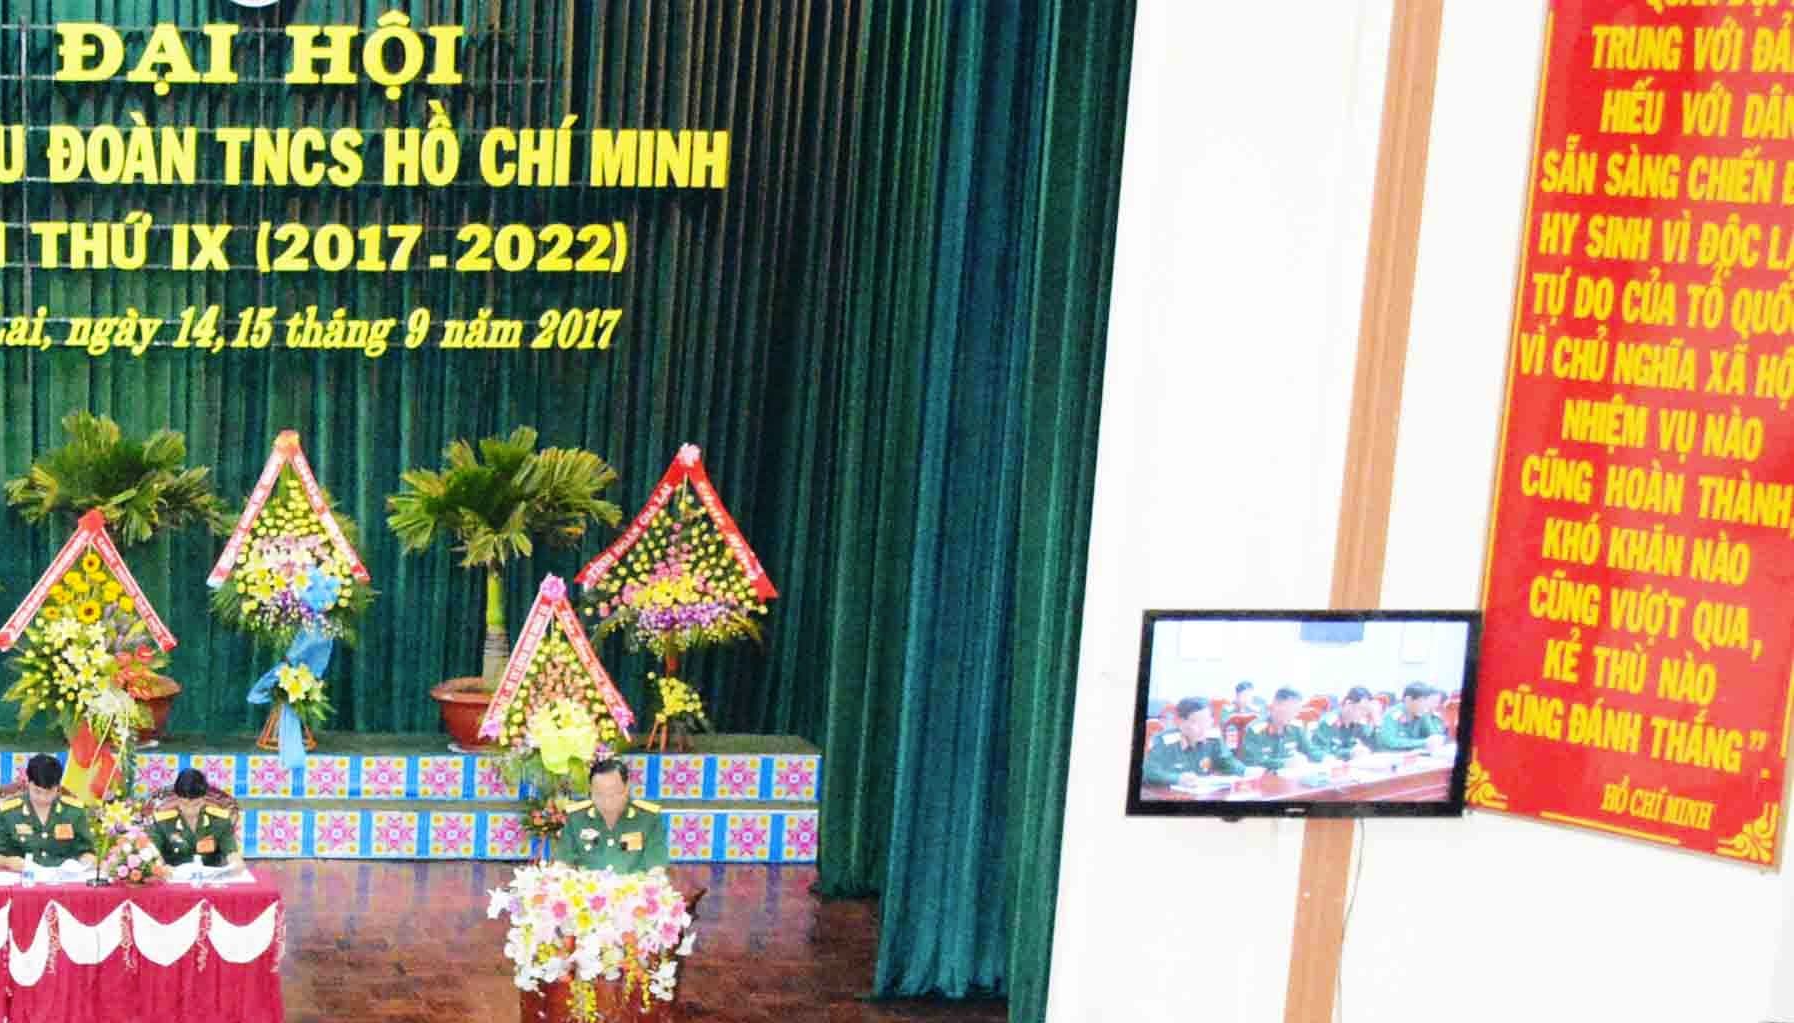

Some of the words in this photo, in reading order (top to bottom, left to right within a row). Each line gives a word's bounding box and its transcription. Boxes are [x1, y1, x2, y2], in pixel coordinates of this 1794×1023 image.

[55, 23, 239, 96] ĐẠI
[285, 9, 464, 101] HỘI
[1591, 25, 1683, 72] TRUNG
[1693, 16, 1744, 73] VỚI
[1751, 11, 1794, 74] ĐẢ
[1600, 76, 1665, 136] HIẾU
[1681, 81, 1732, 138] VỚI
[46, 111, 197, 185] ĐOÀN
[216, 127, 363, 187] TNCS
[384, 99, 460, 186] HỒ
[479, 114, 578, 187] CHÍ
[590, 128, 729, 188] MINH
[1540, 134, 1598, 195] SẴN
[1604, 143, 1681, 202] SÀNG
[1687, 145, 1775, 205] CHIẾN
[32, 211, 153, 270] THỨ
[171, 222, 232, 270] IX
[1538, 211, 1580, 256] HY
[1585, 214, 1653, 262] SINH
[1661, 210, 1691, 265] VÌ
[1697, 213, 1761, 277] ĐỘC
[67, 307, 162, 356] ngày
[286, 305, 396, 357] tháng
[406, 308, 430, 349] 9
[441, 309, 523, 349] năm
[533, 308, 623, 350] 2017
[1533, 268, 1571, 326] TỰ
[1574, 275, 1614, 321] DO
[1622, 267, 1676, 327] CỦA
[1687, 264, 1727, 331] TỔ
[1731, 280, 1794, 341] QUỐ
[1520, 323, 1547, 376] VÌ
[1553, 324, 1609, 384] CHỦ
[1613, 338, 1696, 392] NGHĨA
[1705, 342, 1748, 396] XÃ
[1754, 345, 1794, 412] HỘ
[1561, 393, 1650, 455] NHIỆM
[1659, 407, 1699, 463] VỤ
[1703, 404, 1765, 462] NÀO
[1521, 448, 1595, 505] CŨNG
[1605, 460, 1685, 516] HOÀN
[1697, 468, 1794, 540] THÀNH,
[1541, 515, 1602, 566] KHÓ
[1607, 524, 1685, 578] KHĂN
[1690, 531, 1752, 587] NÀO
[1529, 569, 1602, 628] CŨNG
[1610, 584, 1686, 647] VƯỢT
[1693, 601, 1763, 661] QUA,
[1543, 626, 1583, 686] KẺ
[1592, 642, 1647, 696] THÙ
[1658, 648, 1717, 708] NÀO
[1494, 682, 1564, 742] CŨNG
[1567, 696, 1642, 756] ĐÁNH
[1629, 785, 1669, 822] CHÍ
[1661, 794, 1716, 831] MINH
